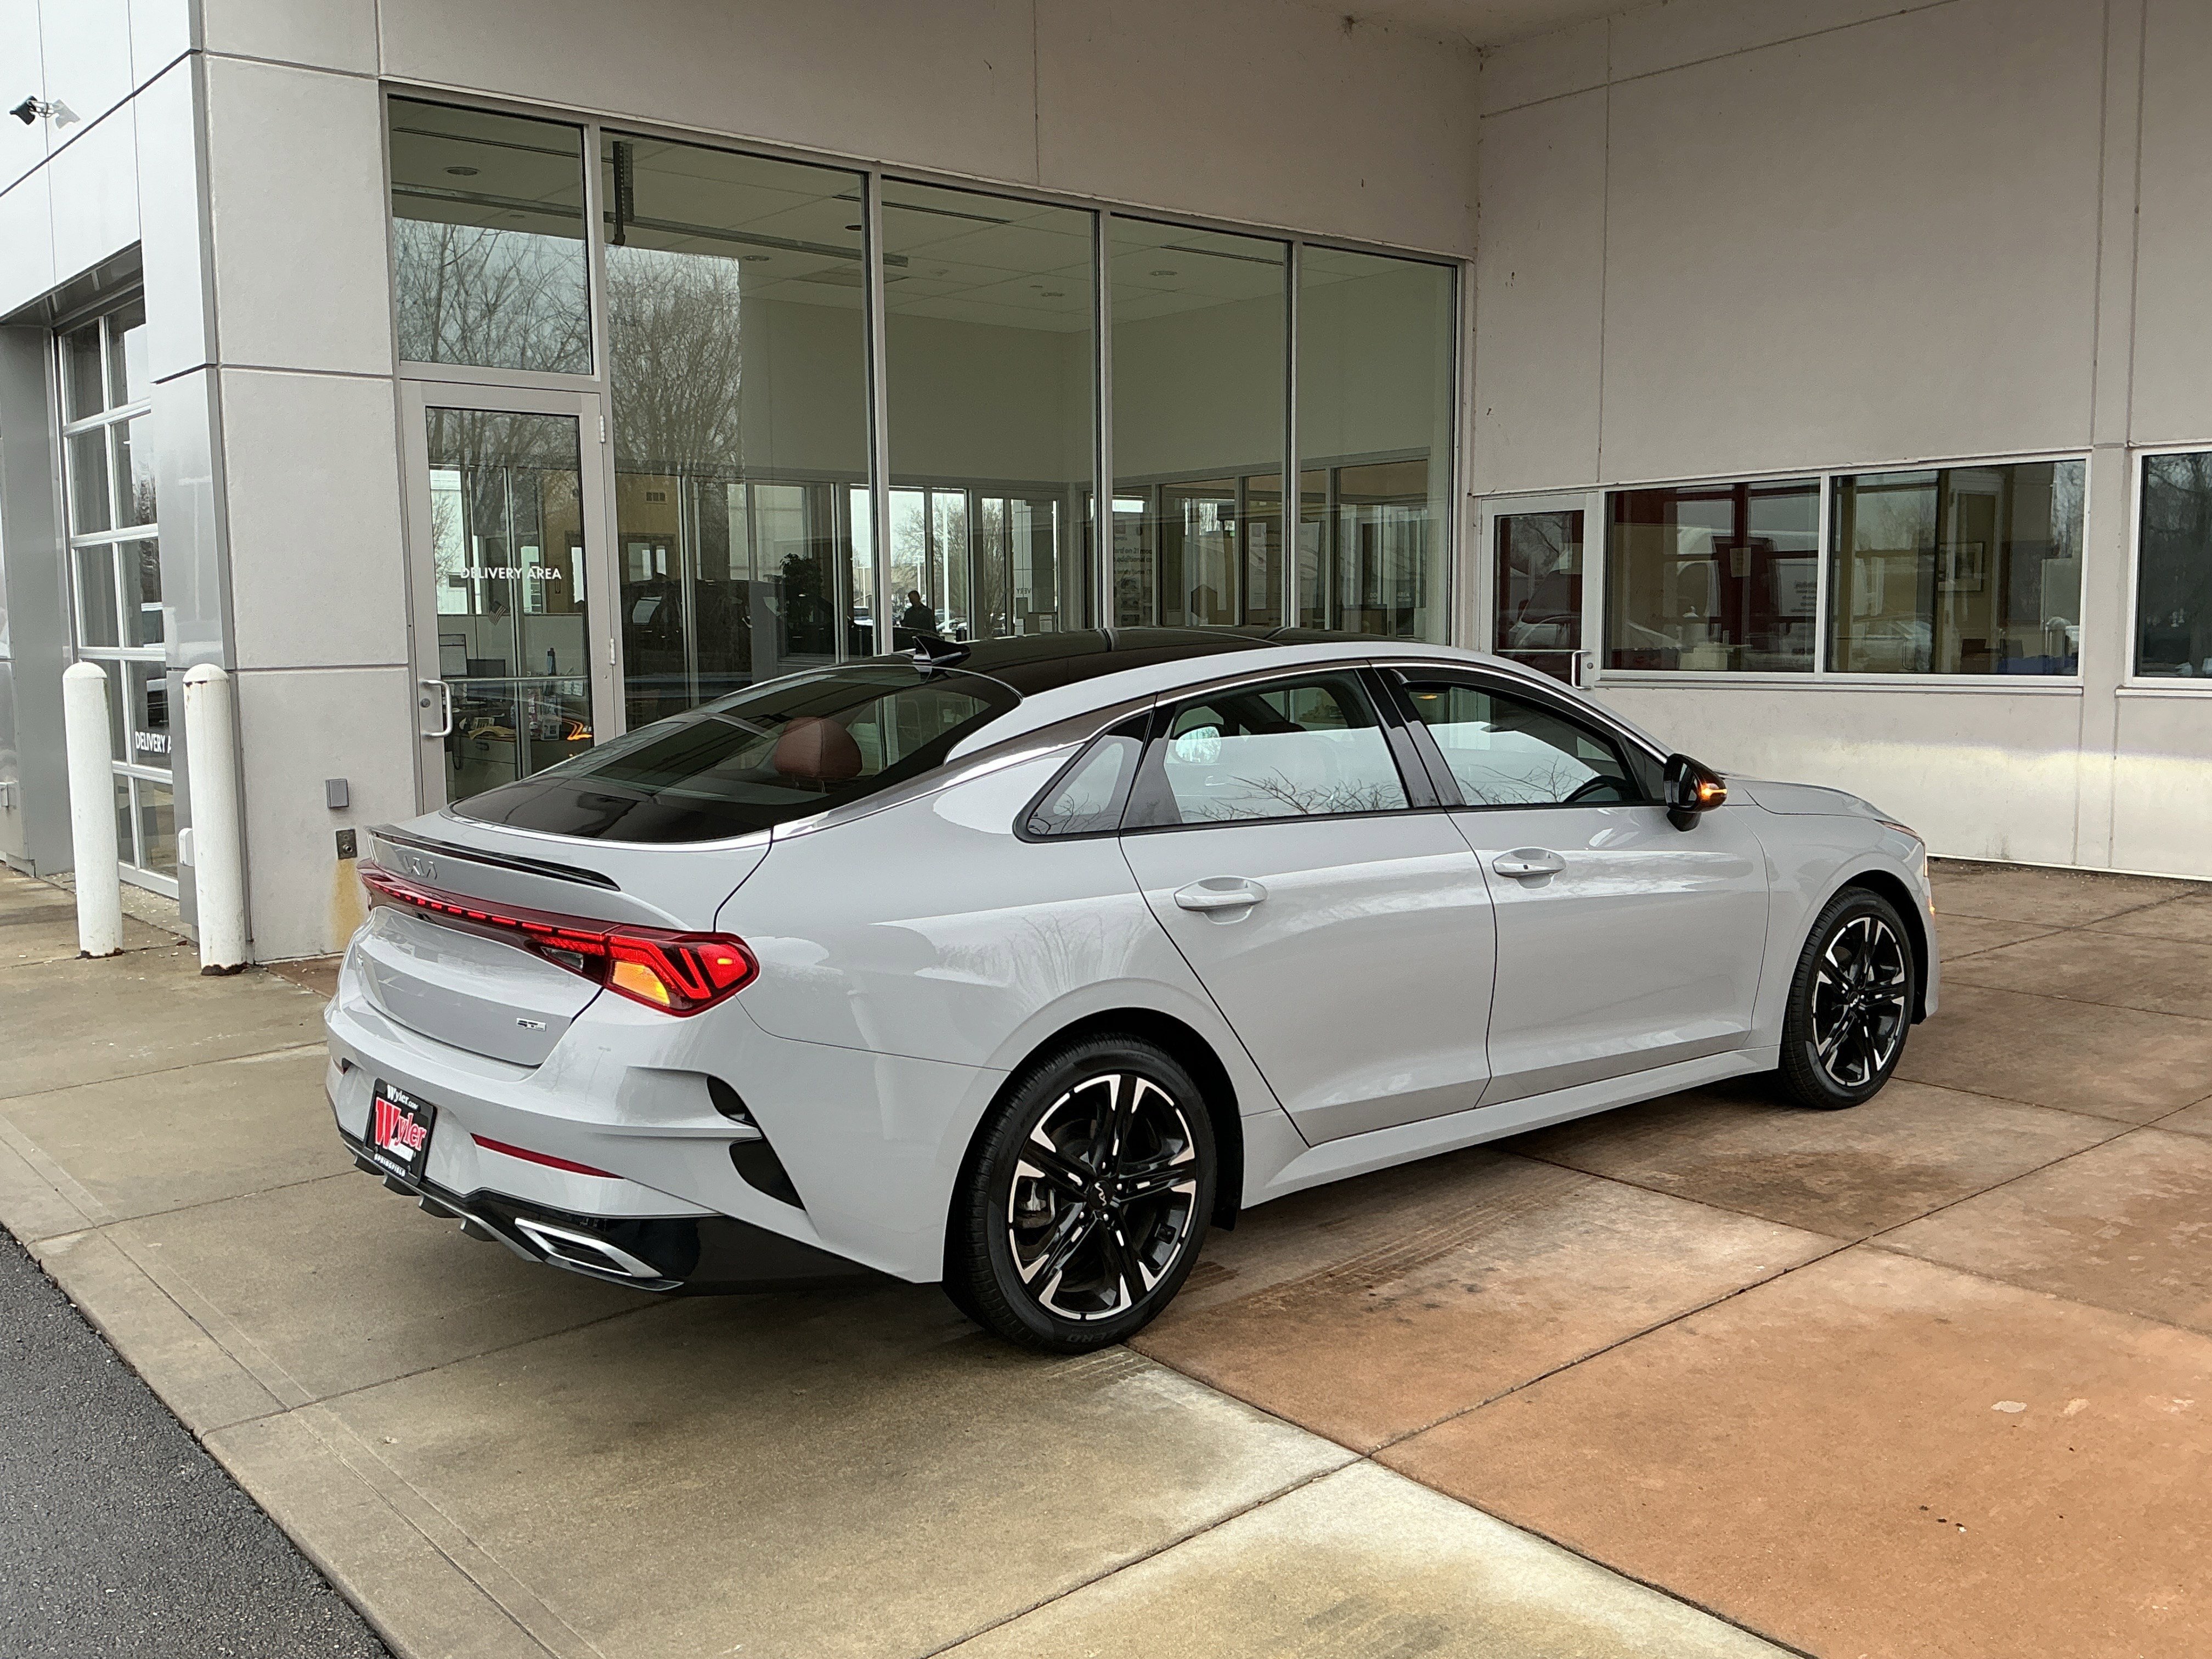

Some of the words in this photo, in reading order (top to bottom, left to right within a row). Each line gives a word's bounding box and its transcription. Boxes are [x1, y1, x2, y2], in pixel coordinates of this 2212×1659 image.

[460, 567, 522, 579] DELIVERY
[527, 567, 562, 579] AREA
[134, 731, 166, 754] DELIVERY
[387, 1084, 419, 1110] Wyler.com
[375, 1097, 427, 1152] Wyler
